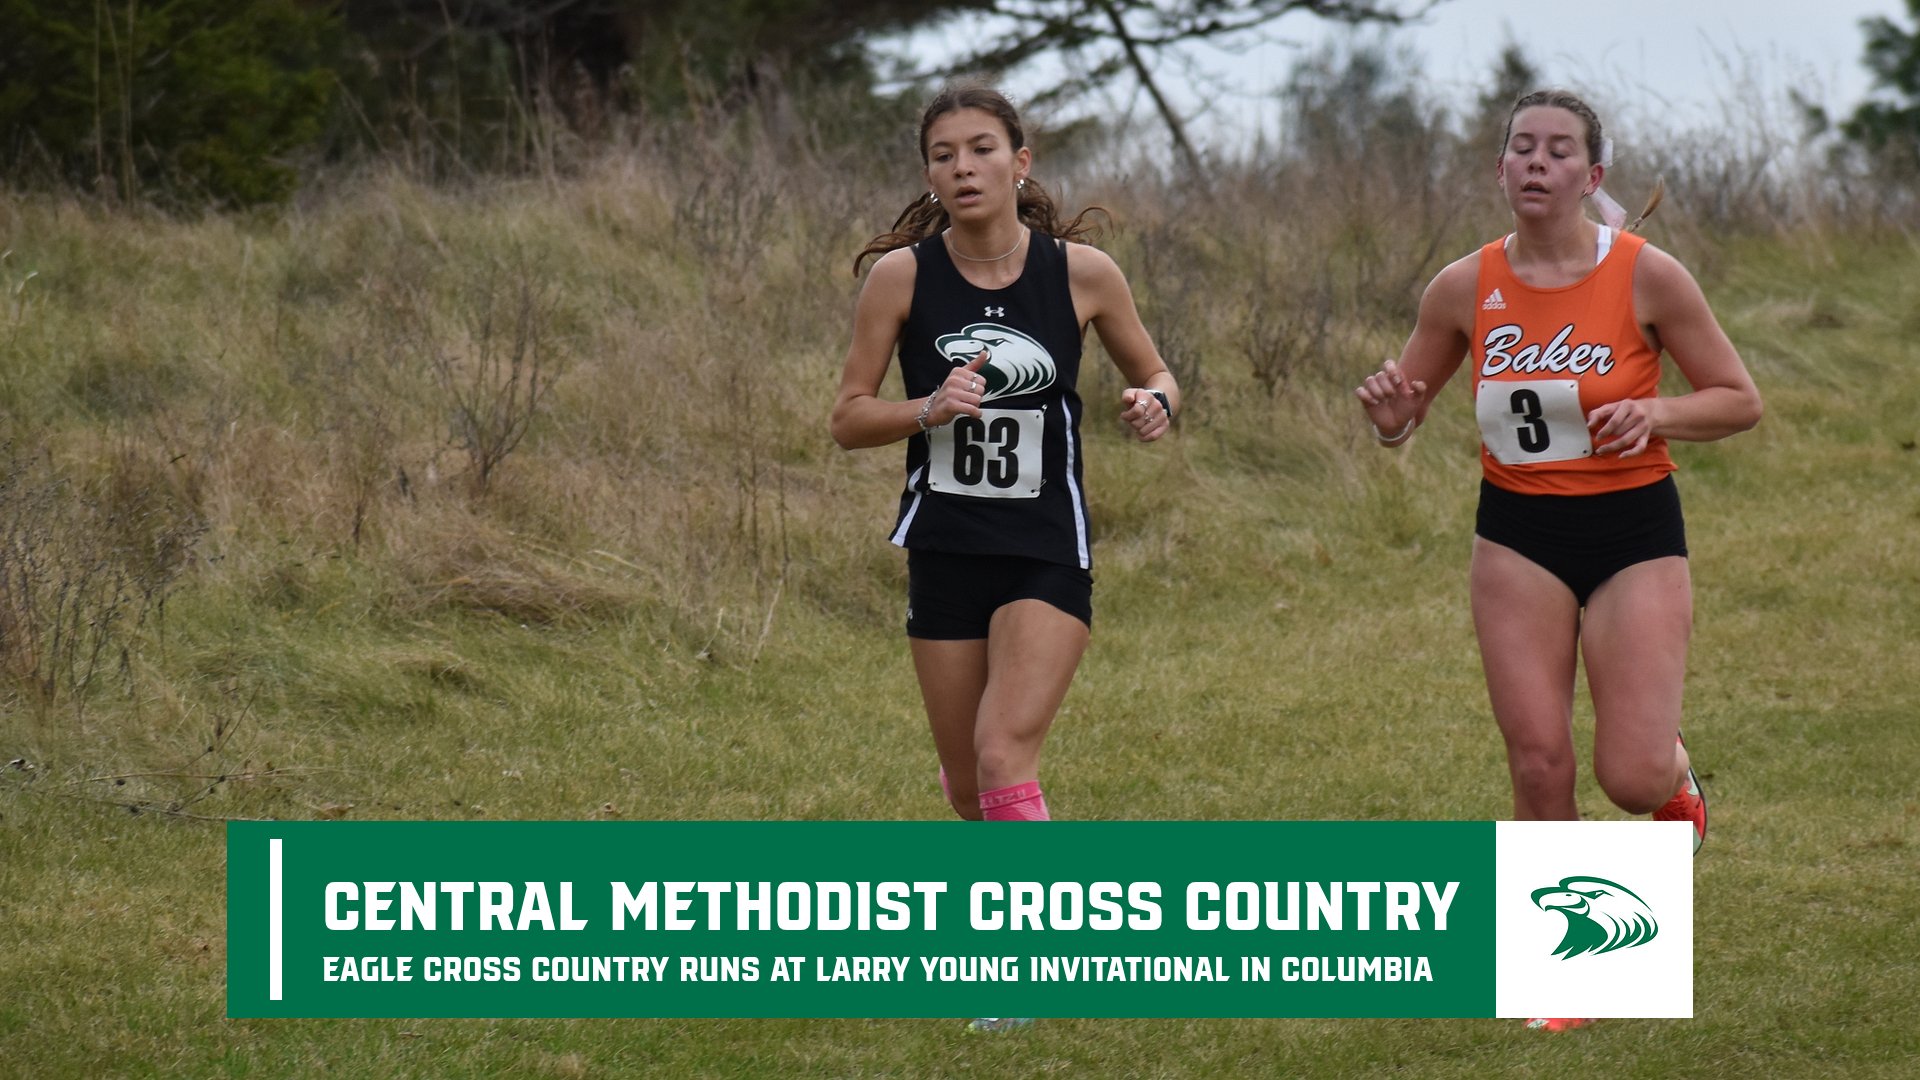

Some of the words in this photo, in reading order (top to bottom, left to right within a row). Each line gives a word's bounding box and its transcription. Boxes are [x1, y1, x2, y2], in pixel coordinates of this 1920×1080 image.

[1482, 302, 1507, 311] adidas
[1481, 323, 1615, 377] Baker
[1510, 388, 1550, 454] 3
[953, 416, 1020, 489] 63
